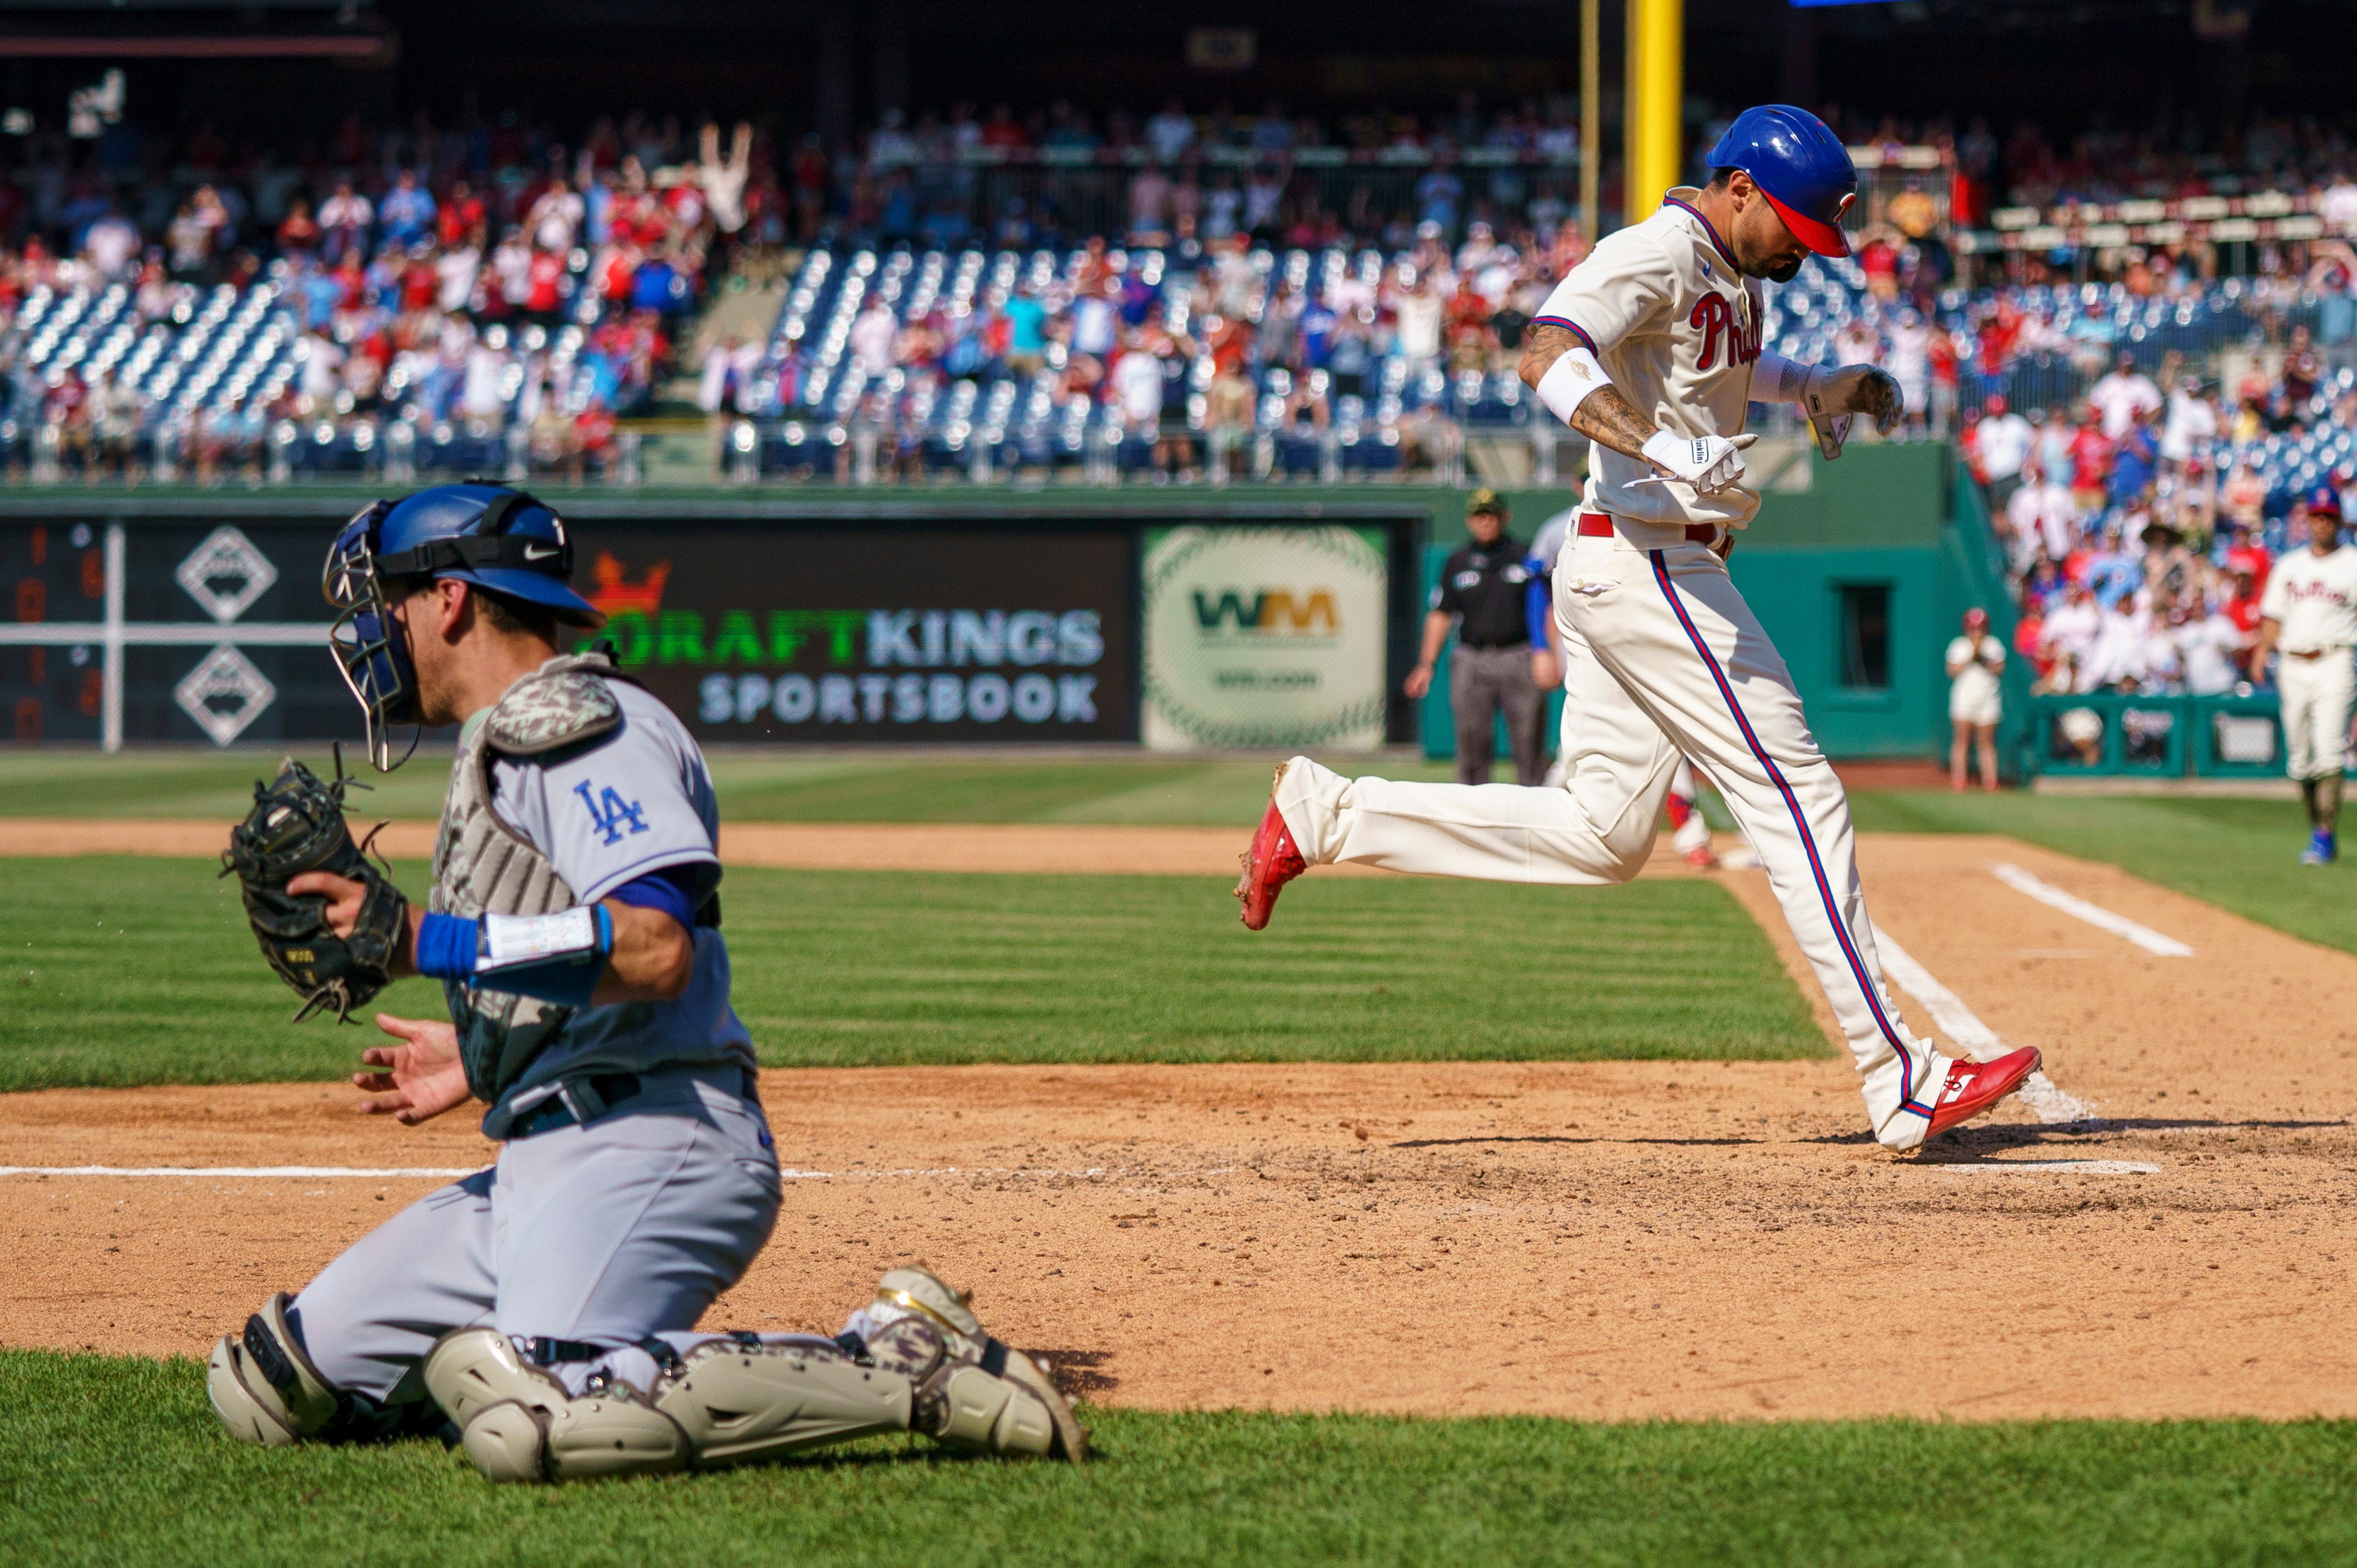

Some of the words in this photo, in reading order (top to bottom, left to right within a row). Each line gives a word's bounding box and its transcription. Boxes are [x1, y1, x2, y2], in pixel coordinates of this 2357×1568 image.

[577, 608, 1104, 668] DRAFTKINGS
[1191, 589, 1343, 634] WM
[698, 672, 1099, 723] SPORTSBOOK
[573, 778, 650, 846] LA
